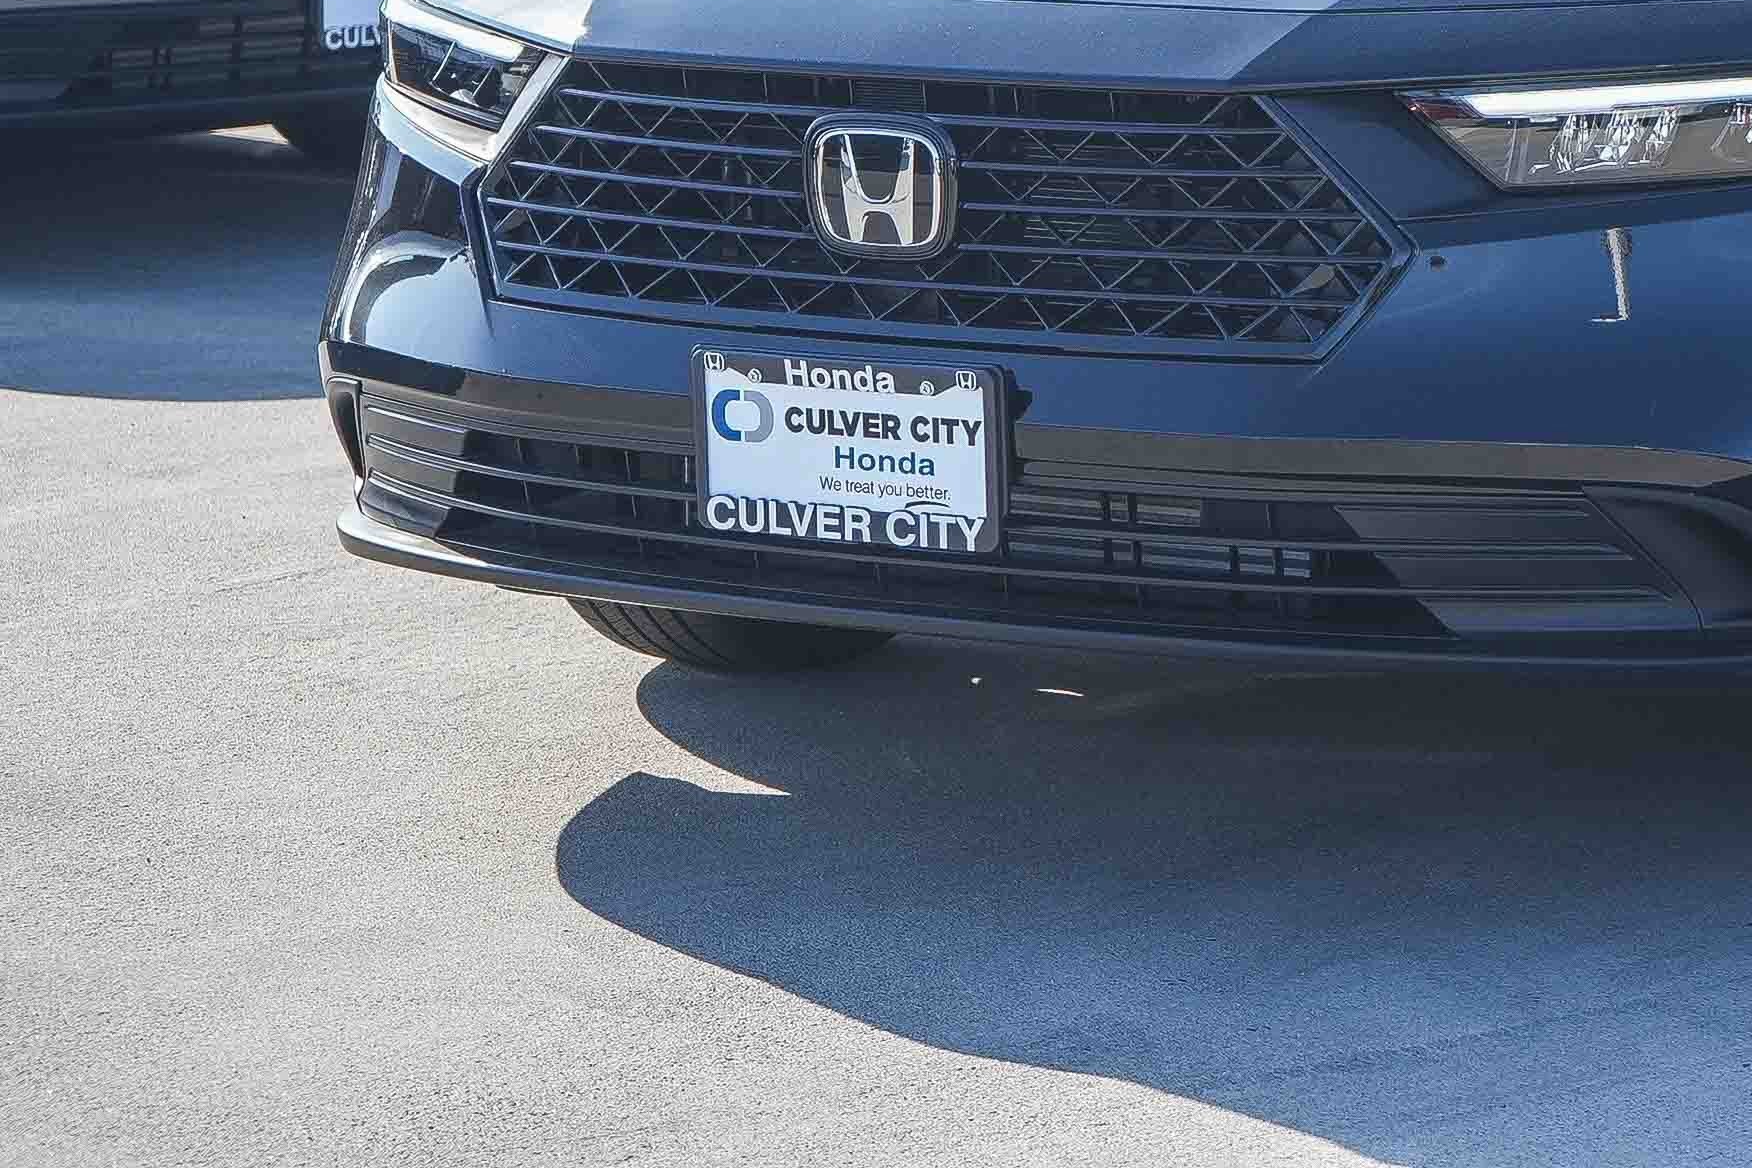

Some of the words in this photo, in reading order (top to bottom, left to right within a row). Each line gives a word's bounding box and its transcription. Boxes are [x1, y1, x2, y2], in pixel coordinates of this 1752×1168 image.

[783, 358, 896, 393] Honda
[784, 406, 902, 440] CULVER
[910, 415, 982, 446] CITY
[834, 445, 935, 476] Honda
[819, 475, 841, 492] We
[845, 479, 874, 494] treat
[878, 483, 902, 498] you
[906, 483, 951, 501] better.
[706, 495, 871, 543] CULVER
[886, 511, 985, 552] CITY
